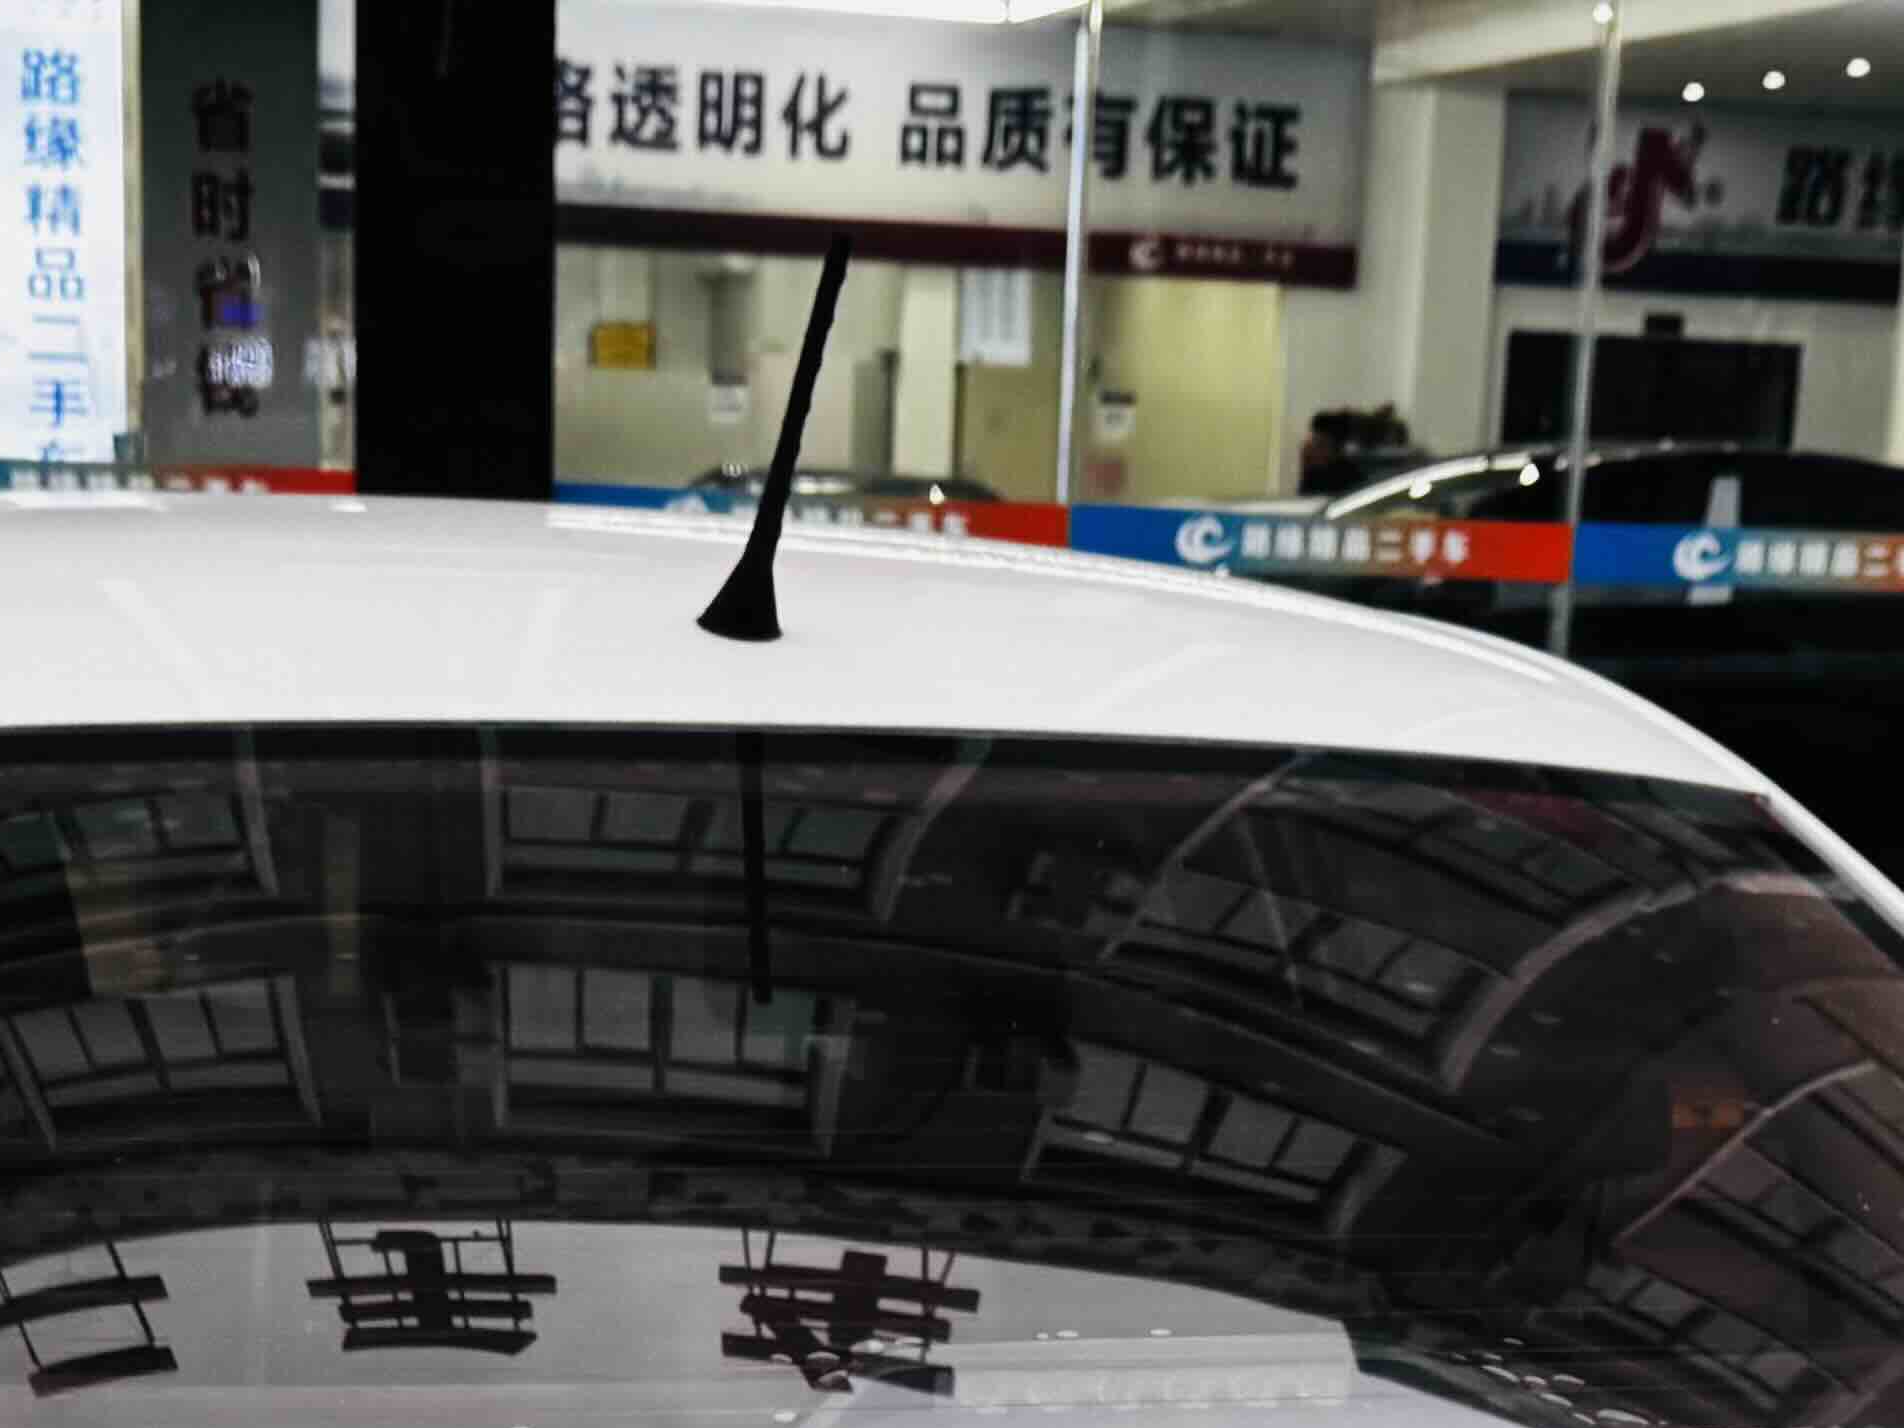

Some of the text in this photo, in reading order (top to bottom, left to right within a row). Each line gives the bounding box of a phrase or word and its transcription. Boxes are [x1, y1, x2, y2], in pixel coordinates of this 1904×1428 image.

[899, 83, 1302, 190] 品质有保证
